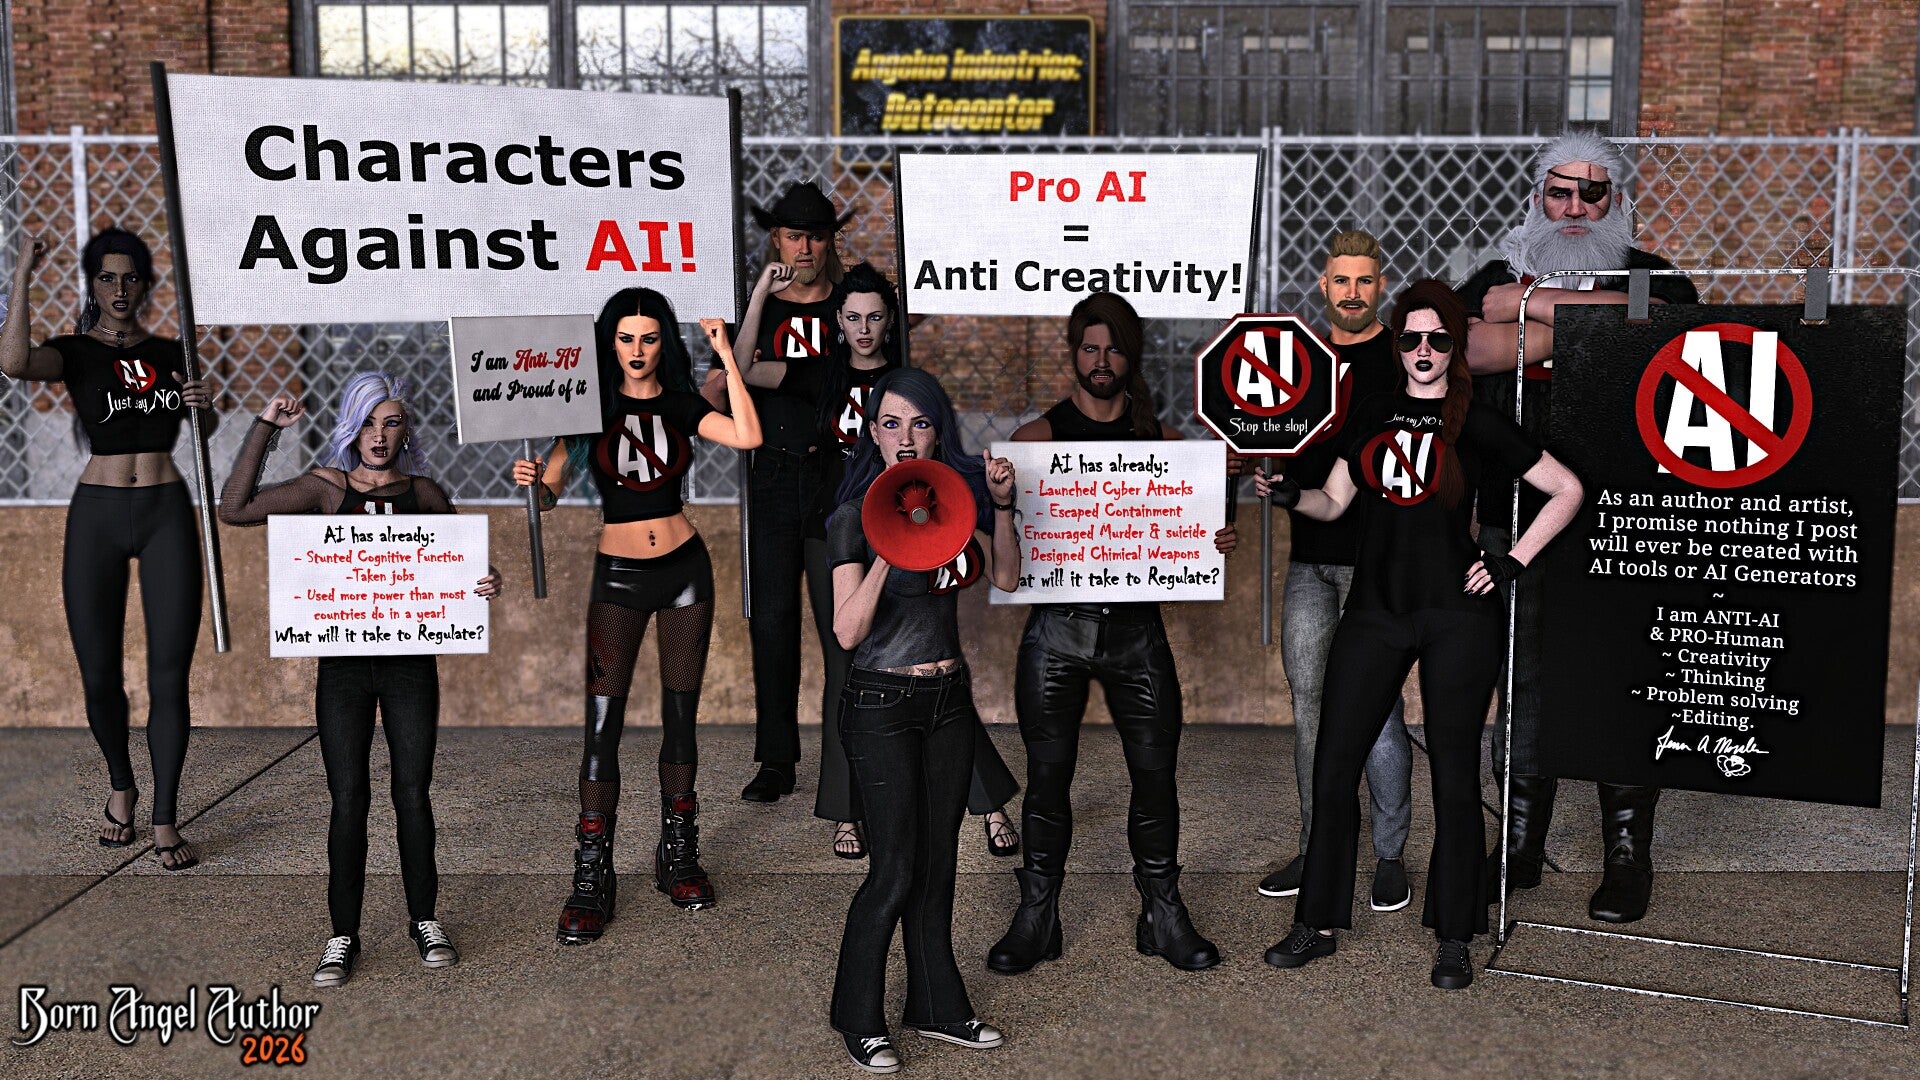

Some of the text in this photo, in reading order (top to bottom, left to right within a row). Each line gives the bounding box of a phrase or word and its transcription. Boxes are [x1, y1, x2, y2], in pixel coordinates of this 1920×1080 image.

[244, 124, 686, 191] Characters
[1010, 171, 1147, 203] Pro AI
[238, 213, 697, 285] Against AI!
[913, 259, 1242, 301] Anti Creativity!
[471, 347, 581, 372] I am Anti-AI
[1234, 331, 1294, 409] AI
[473, 378, 587, 403] and Proud of it
[1657, 331, 1778, 473] AI
[98, 389, 180, 423] Just say NO
[1225, 418, 1308, 436] Stop the slop!
[1050, 453, 1169, 478] AI has already:
[1038, 480, 1097, 497] Launched
[1102, 481, 1141, 500] Cyber
[1146, 479, 1193, 496] Attacks
[1049, 502, 1099, 522] Escaped
[1104, 503, 1183, 518] Containment
[1598, 490, 1853, 517] As an author and artist,
[324, 525, 435, 547] AI has already:
[1024, 523, 1206, 544] Encouraged Murder & suicide
[1598, 512, 1858, 542] I promise nothing I post
[307, 550, 352, 563] Stunted
[358, 550, 411, 566] Cognitive
[417, 548, 464, 563] Function
[1030, 545, 1200, 565] Designed Chimical Weapons
[1589, 536, 1858, 563] will ever be created with
[346, 567, 415, 585] -Taken jobs
[1041, 567, 1064, 586] will
[1071, 571, 1081, 587] it
[1088, 568, 1119, 587] take
[1126, 572, 1141, 585] to
[1148, 566, 1219, 589] Regulate?
[1589, 558, 1856, 587] AI tools or AI Generators
[307, 588, 335, 601] Used
[341, 591, 367, 601] more
[373, 591, 404, 604] power
[409, 588, 434, 600] than
[440, 590, 466, 600] most
[314, 606, 446, 622] countries do in a year!
[1657, 607, 1780, 628] I am ANTI-AI
[275, 624, 484, 644] What will it take to Regulate?
[1650, 627, 1784, 648] & PRO-Human
[1678, 649, 1771, 672] Creativity
[1681, 669, 1766, 692] Thinking
[1647, 687, 1724, 706] Problem
[1730, 694, 1799, 715] solving
